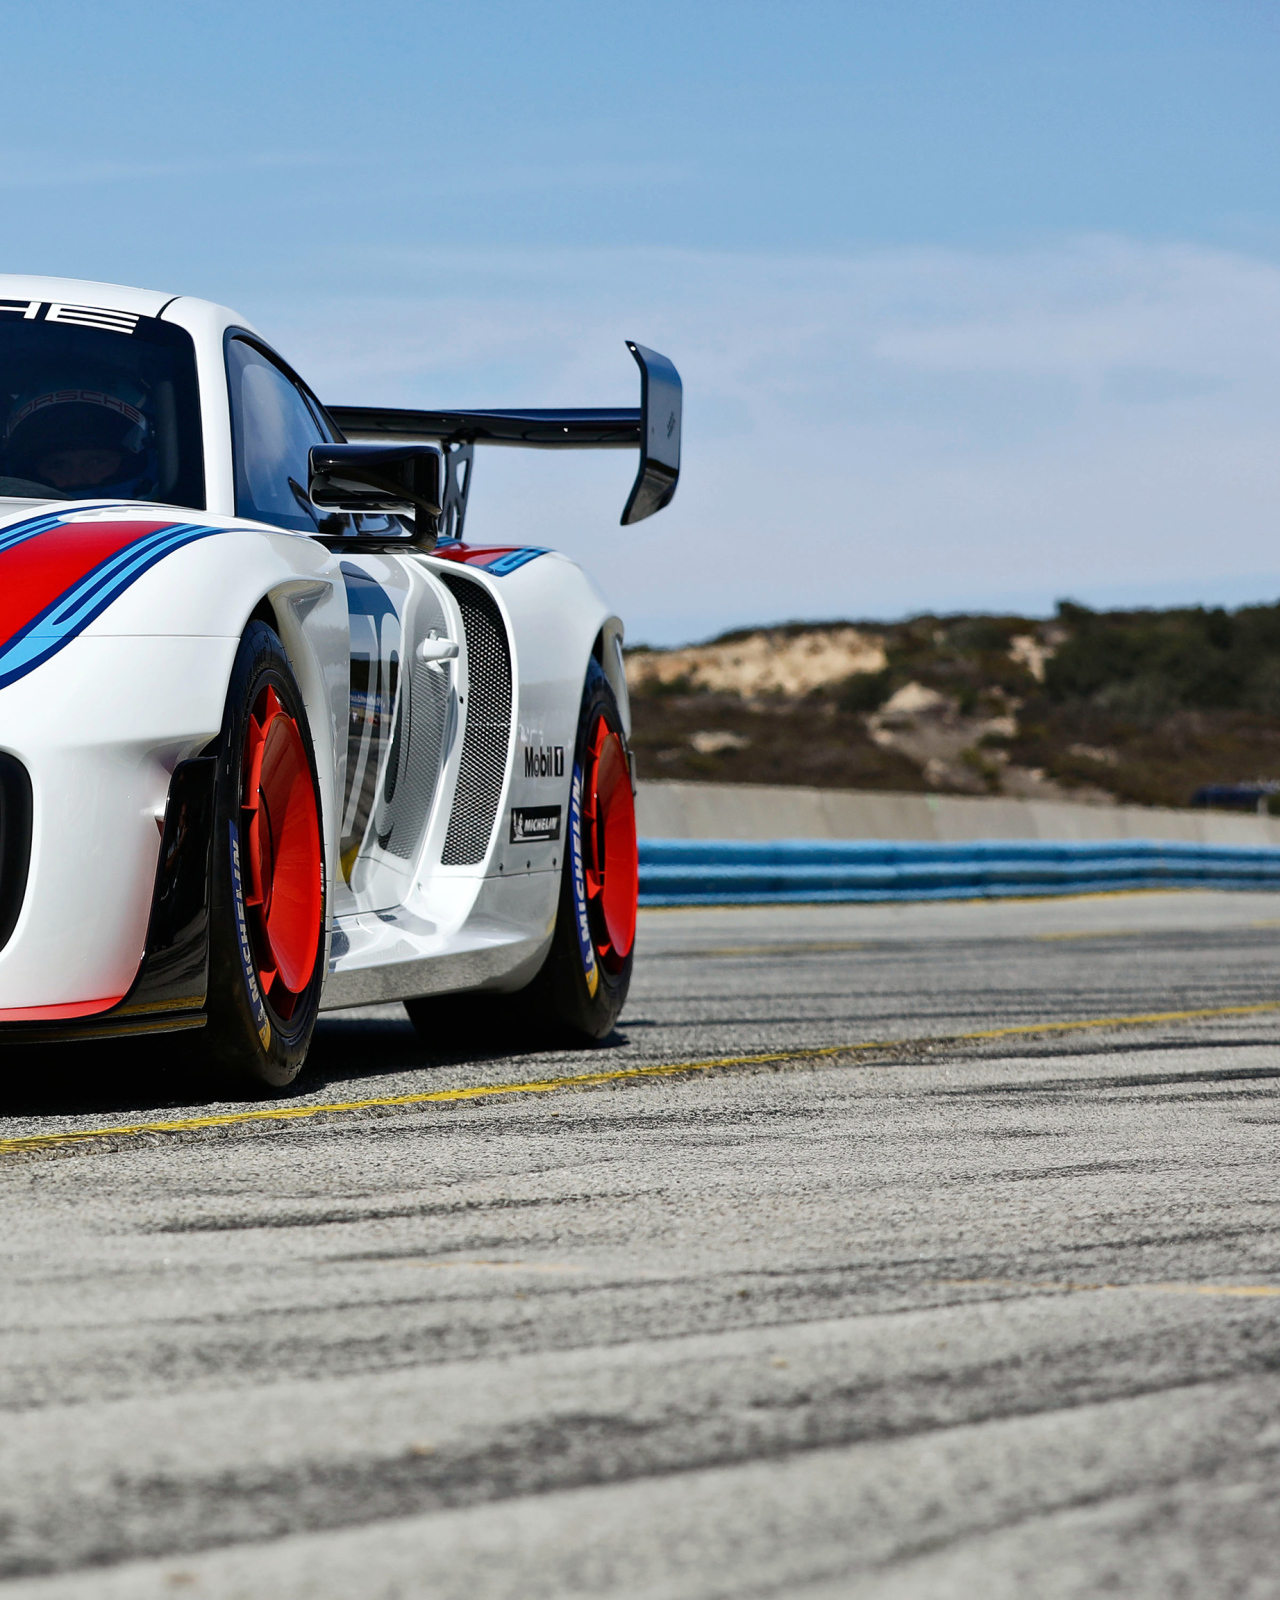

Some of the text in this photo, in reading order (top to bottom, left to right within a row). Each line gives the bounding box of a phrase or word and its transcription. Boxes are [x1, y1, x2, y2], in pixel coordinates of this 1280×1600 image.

[524, 746, 564, 777] Mobil 1
[524, 817, 558, 832] MICHELIN
[572, 776, 589, 942] MICHELIN
[232, 839, 259, 1003] MICHELIN
